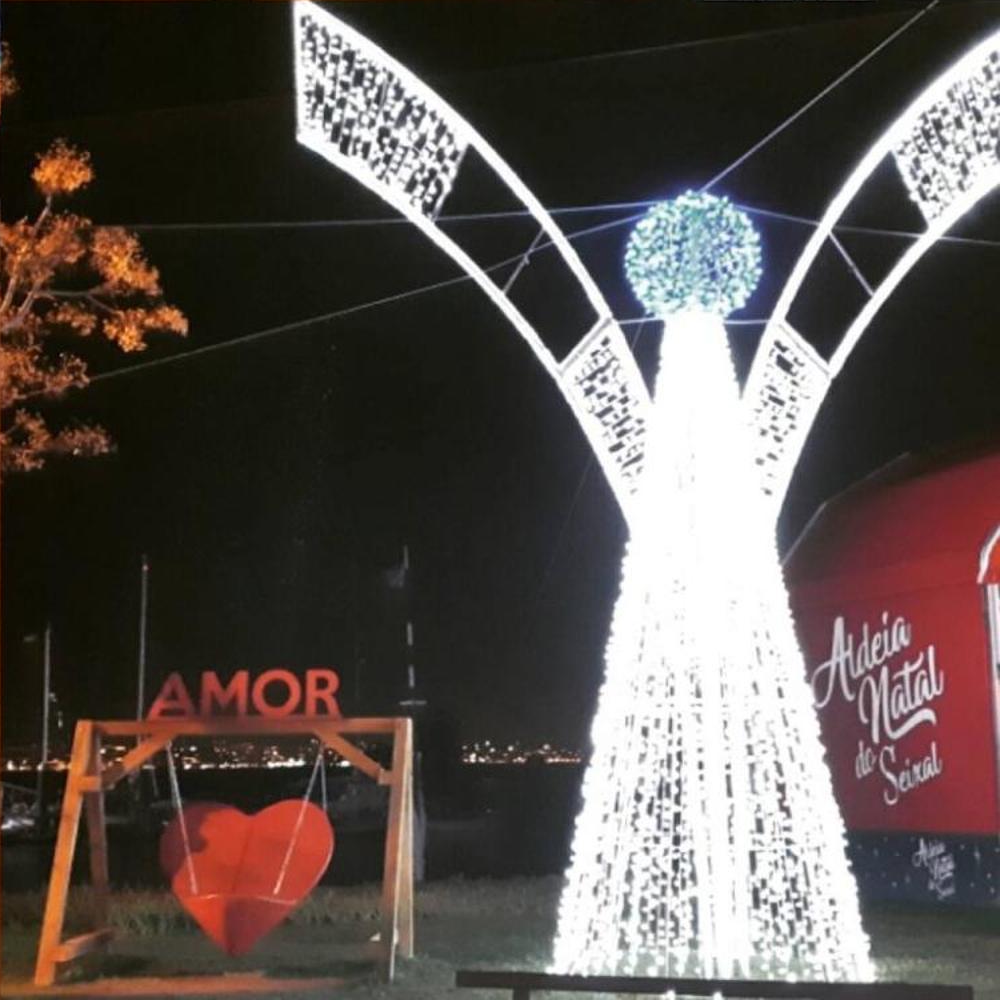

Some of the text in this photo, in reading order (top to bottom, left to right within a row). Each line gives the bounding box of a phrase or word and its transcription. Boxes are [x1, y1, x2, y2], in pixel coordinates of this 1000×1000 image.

[147, 668, 342, 719] AMOR
[811, 611, 911, 708] Aldeia
[858, 645, 944, 743] Natal
[856, 740, 943, 806] do Seixal
